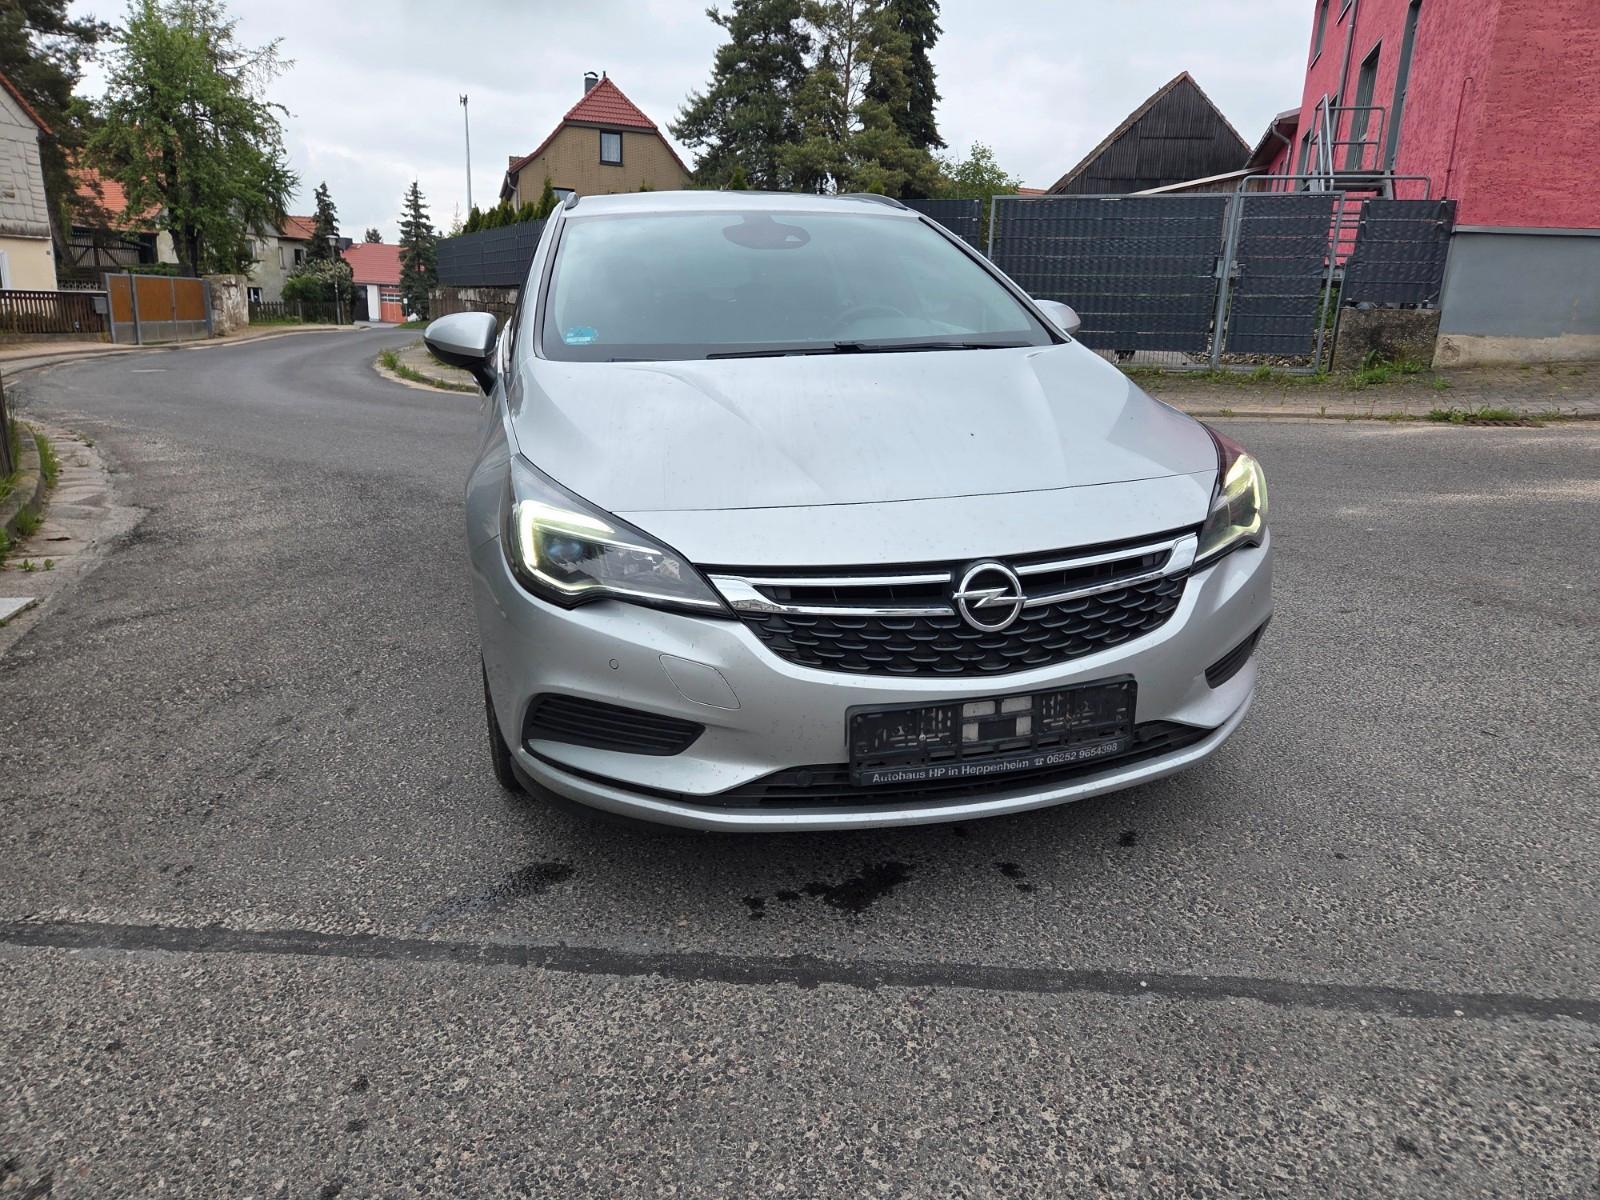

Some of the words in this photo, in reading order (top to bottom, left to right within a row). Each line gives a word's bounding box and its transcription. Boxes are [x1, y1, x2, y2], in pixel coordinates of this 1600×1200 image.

[872, 771, 926, 783] Autohaus
[928, 767, 946, 778] HP
[948, 767, 959, 776] in
[961, 759, 1029, 775] Heppenheim
[1046, 751, 1077, 764] 06252
